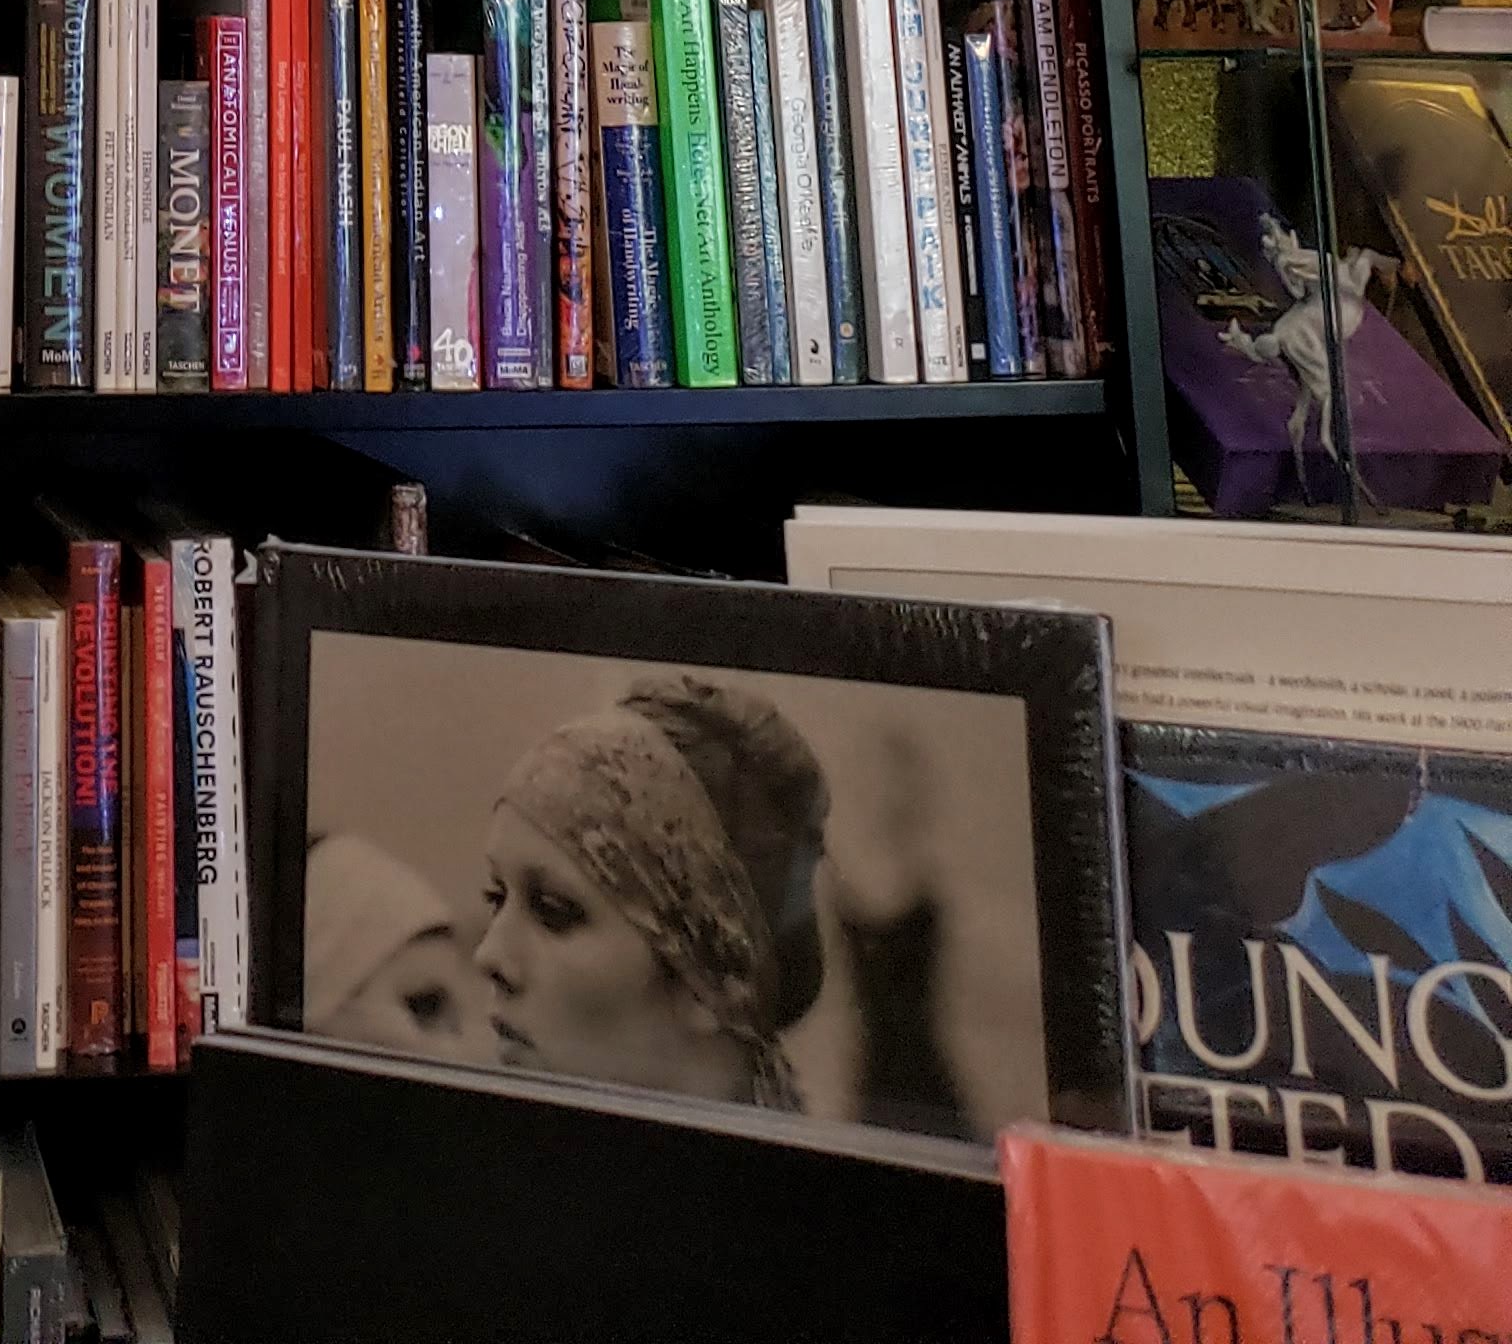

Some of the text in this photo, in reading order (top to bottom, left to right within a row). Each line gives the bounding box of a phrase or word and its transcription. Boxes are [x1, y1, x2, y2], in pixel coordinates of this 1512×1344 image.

[677, 0, 696, 37] Art
[682, 39, 706, 127] Happens
[1038, 43, 1067, 179] PENDLETON
[221, 51, 240, 275] ANATOMICAL VENUS
[42, 124, 84, 342] WOMEN
[168, 148, 200, 314] MONET
[692, 192, 713, 232] Net
[696, 236, 714, 267] Art
[41, 348, 83, 364] MoMA
[168, 359, 205, 372] TASCHEN
[697, 269, 724, 378] Anthology
[192, 539, 218, 886] ROBERT RAUSCHENBERG
[1263, 1263, 1512, 1344] Ill
